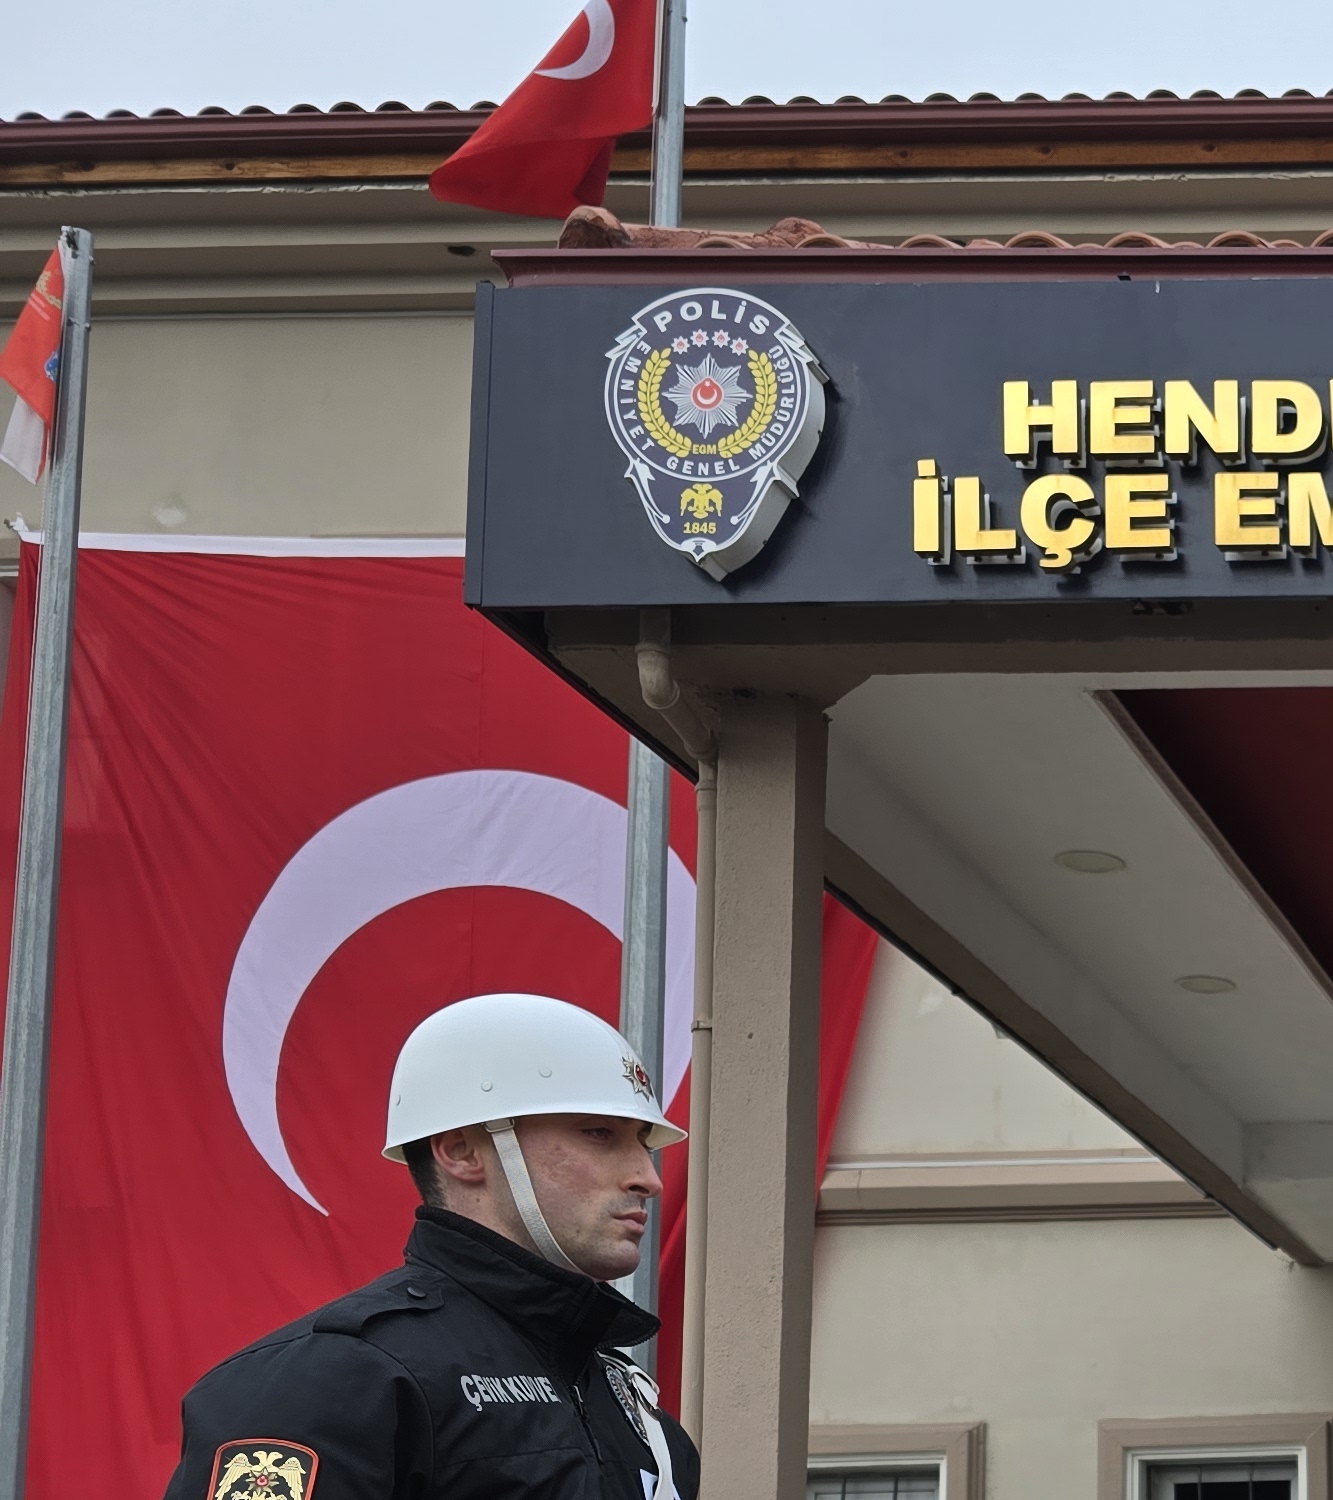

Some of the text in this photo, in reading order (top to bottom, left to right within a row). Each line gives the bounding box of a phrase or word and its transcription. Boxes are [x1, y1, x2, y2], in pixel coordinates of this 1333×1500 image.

[653, 300, 770, 334] POLİS
[620, 340, 795, 476] EMNİYET GENEL MÜDÜRLÜĞÜ
[692, 444, 717, 455] EGM
[683, 522, 717, 534] 1845
[915, 460, 1171, 568] İLÇE
